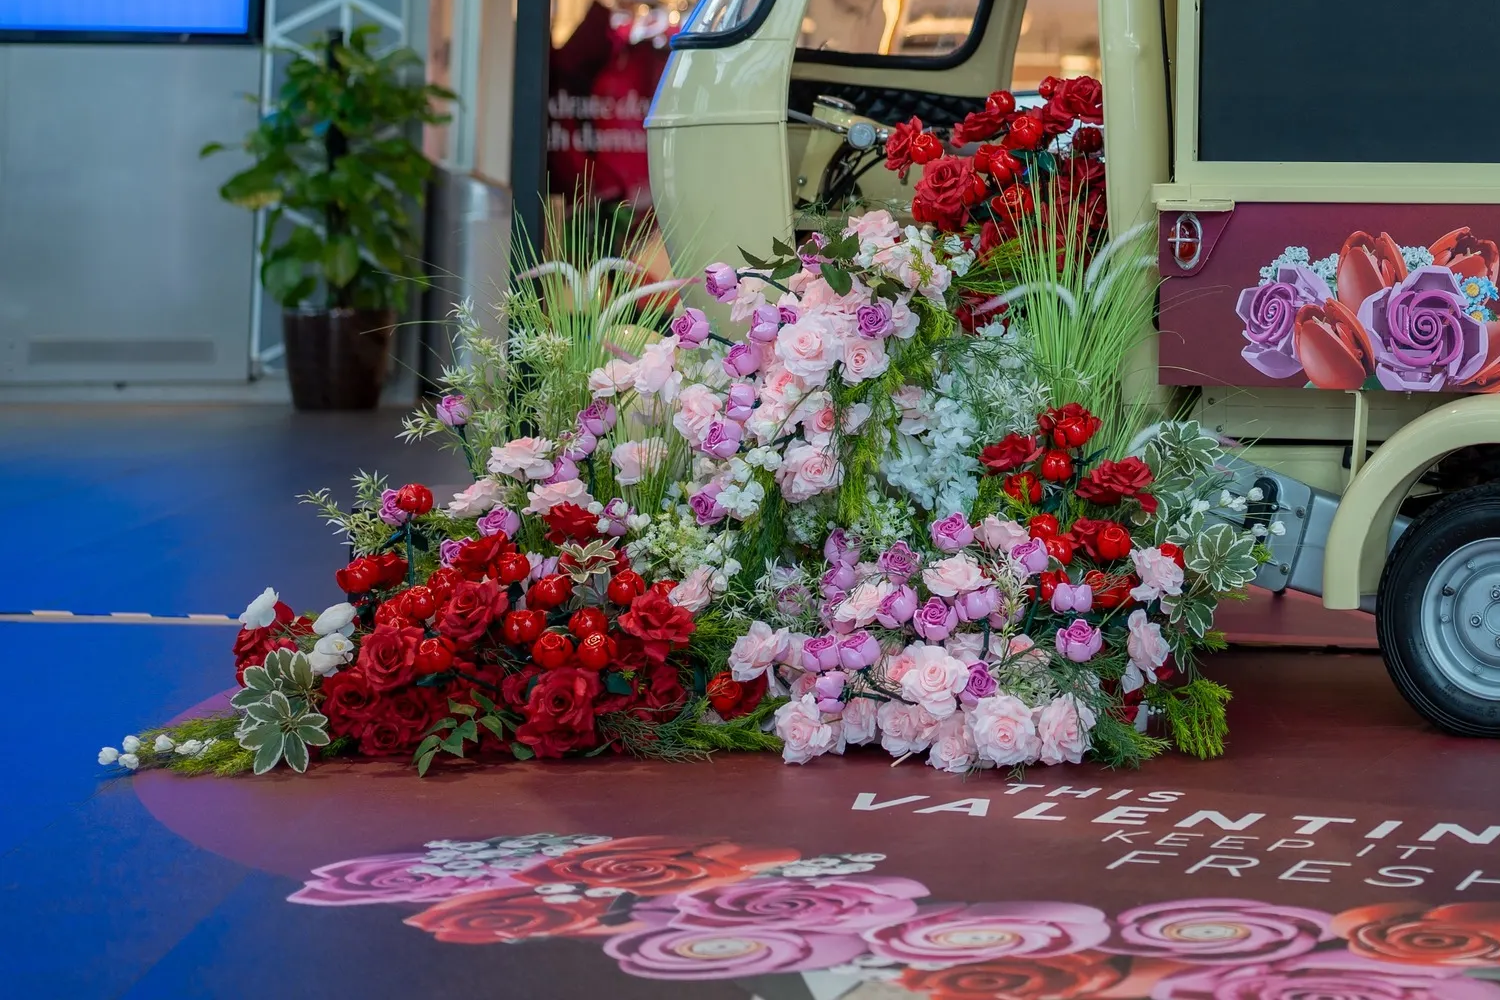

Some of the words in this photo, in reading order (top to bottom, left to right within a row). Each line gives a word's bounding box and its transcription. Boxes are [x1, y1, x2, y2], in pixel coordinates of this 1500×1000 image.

[1003, 783, 1185, 803] THIS
[1101, 829, 1316, 852] KEEP
[1356, 843, 1436, 860] IT
